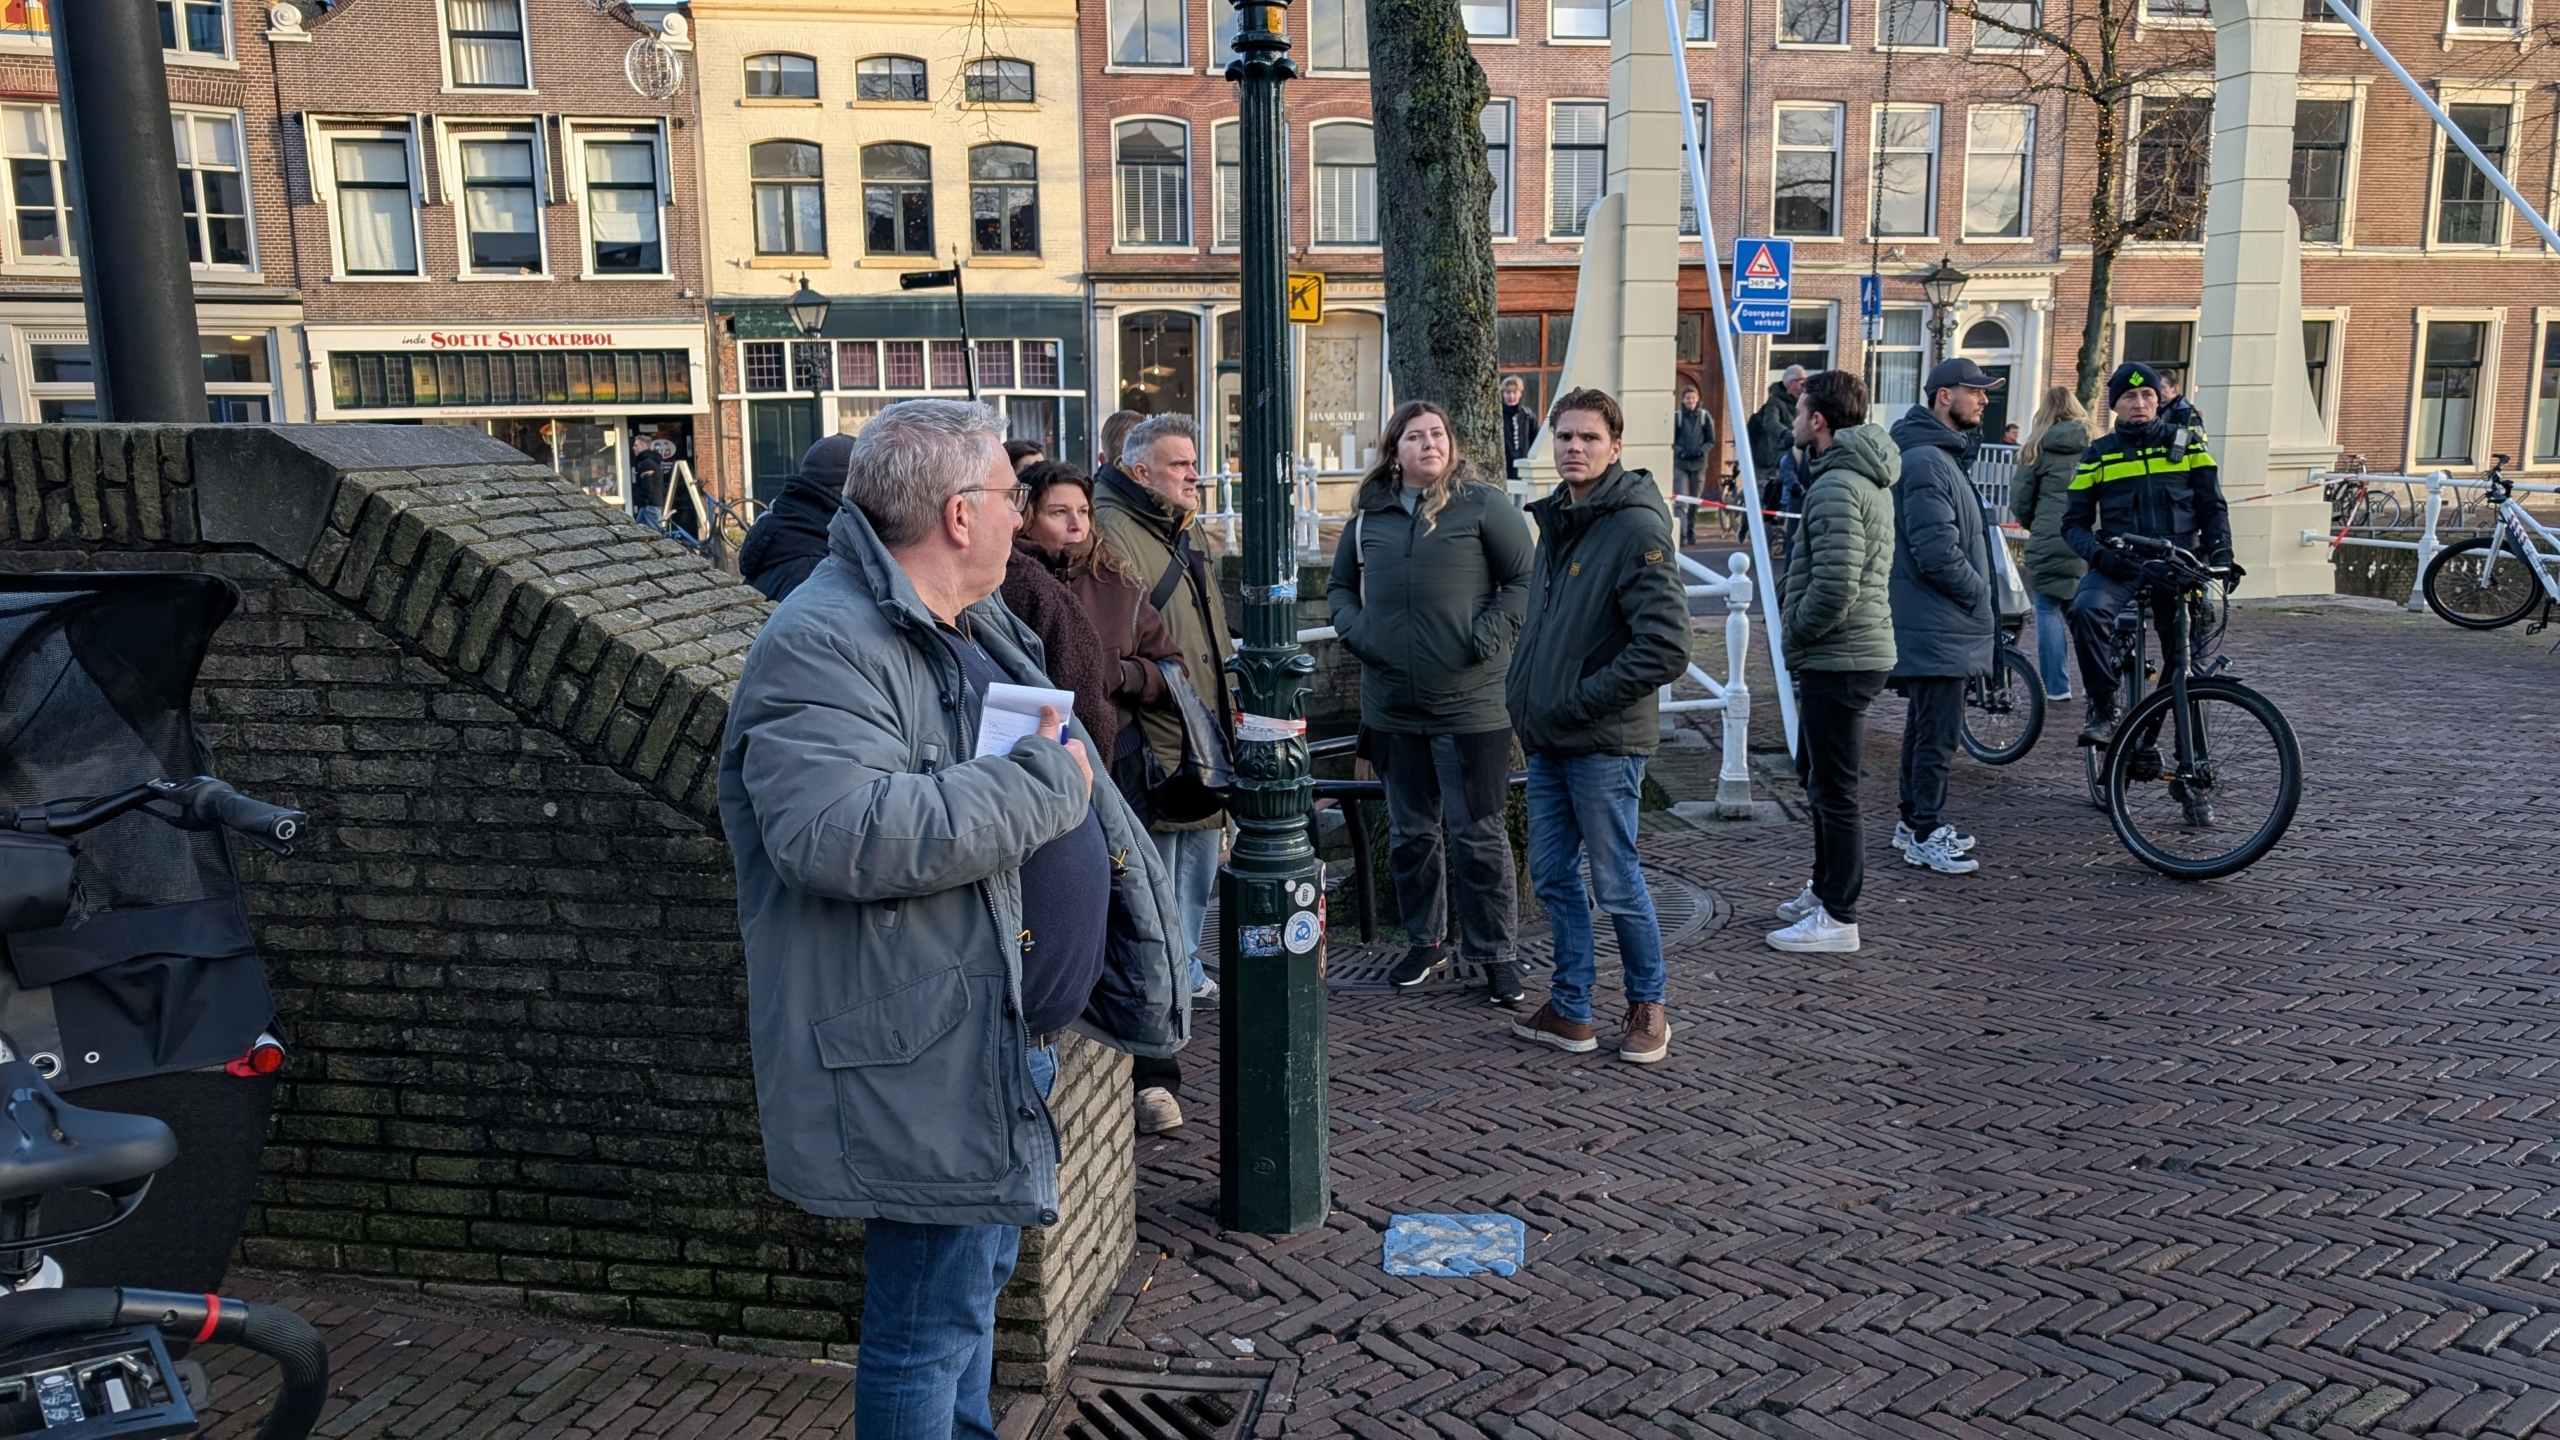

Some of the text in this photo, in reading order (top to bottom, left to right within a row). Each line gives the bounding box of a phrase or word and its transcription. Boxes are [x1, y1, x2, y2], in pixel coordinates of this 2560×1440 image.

[1291, 285, 1311, 311] K
[1742, 308, 1785, 319] Doorgaand
[431, 332, 493, 349] SOETE
[498, 332, 617, 348] SUYCKERBOL
